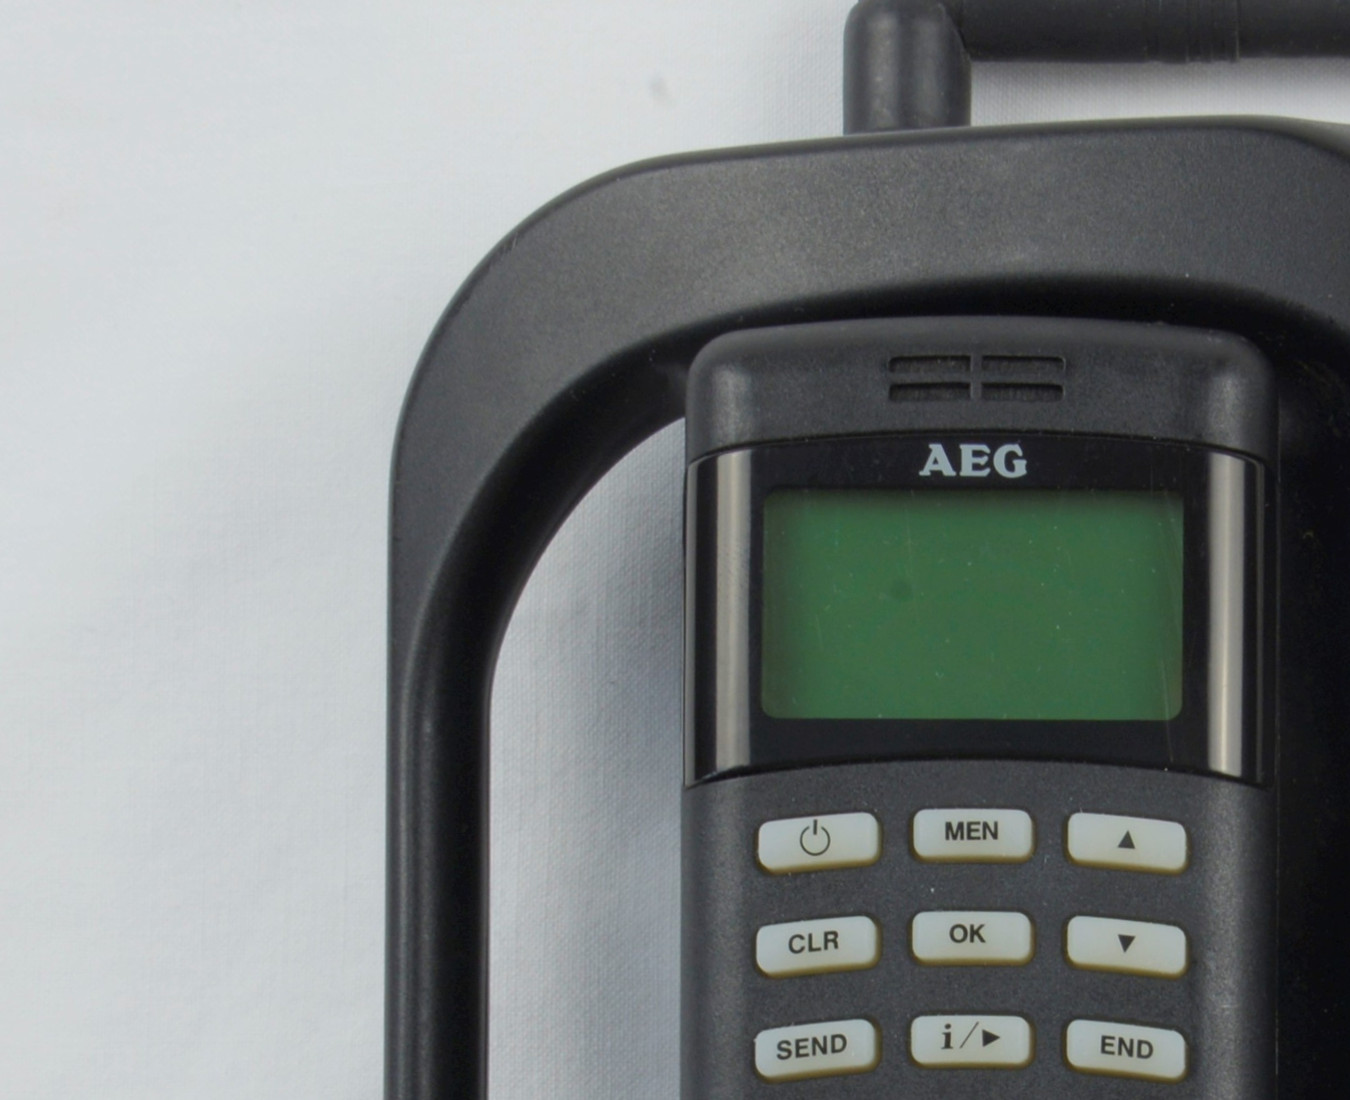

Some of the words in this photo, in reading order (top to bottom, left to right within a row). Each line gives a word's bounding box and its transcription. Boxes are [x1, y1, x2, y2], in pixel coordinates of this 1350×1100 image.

[918, 443, 1027, 479] AEG
[944, 820, 999, 841] MEN
[788, 930, 839, 955] CLR
[949, 923, 986, 944] OK
[776, 1033, 848, 1061] SEND
[1100, 1035, 1154, 1060] END
